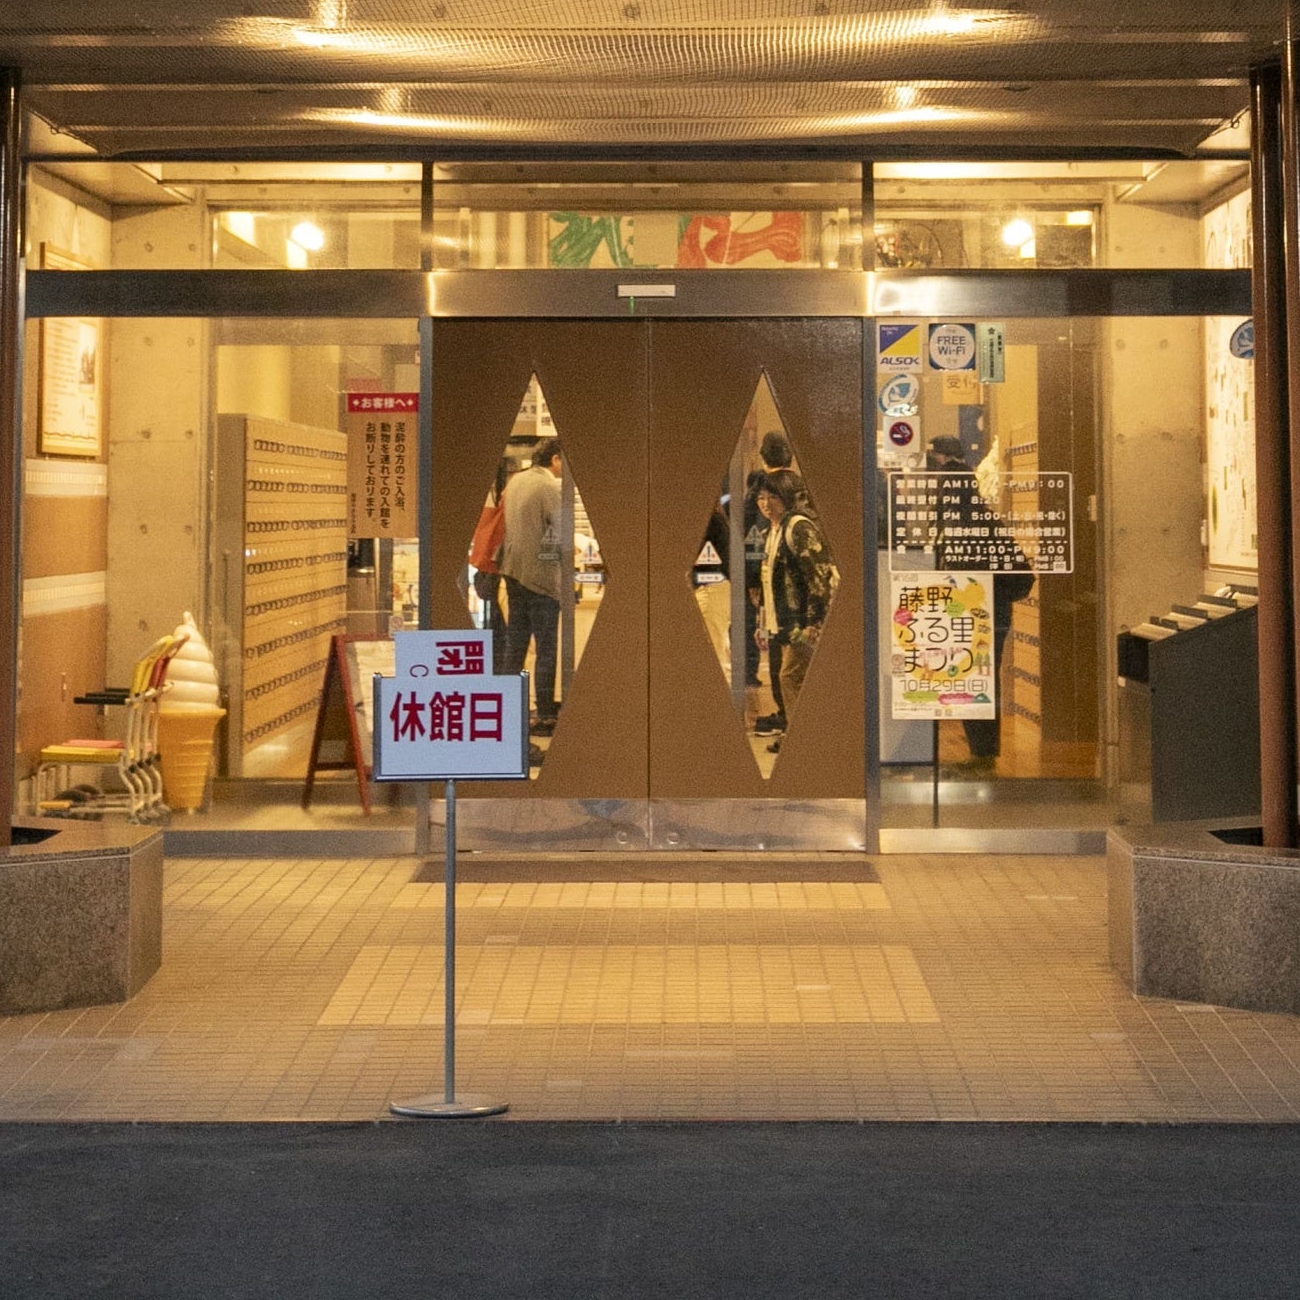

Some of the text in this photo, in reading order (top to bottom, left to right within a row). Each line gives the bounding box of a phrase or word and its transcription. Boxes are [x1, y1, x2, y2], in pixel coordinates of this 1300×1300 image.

[937, 336, 966, 345] FREE
[938, 346, 966, 356] Wi-Fi
[880, 357, 920, 366] ALSOK
[361, 397, 407, 409] お客様へ
[365, 422, 376, 522] お断りしております。
[380, 422, 391, 528] 動物を連れての入館を
[943, 496, 960, 504] PM
[971, 496, 1000, 504] 8:20
[943, 512, 960, 520] PM
[900, 587, 953, 613] 藤野
[898, 617, 974, 643] ふる里
[904, 647, 974, 673] まつり
[900, 680, 988, 692] 10月29日(日)
[389, 691, 503, 742] 休館日
